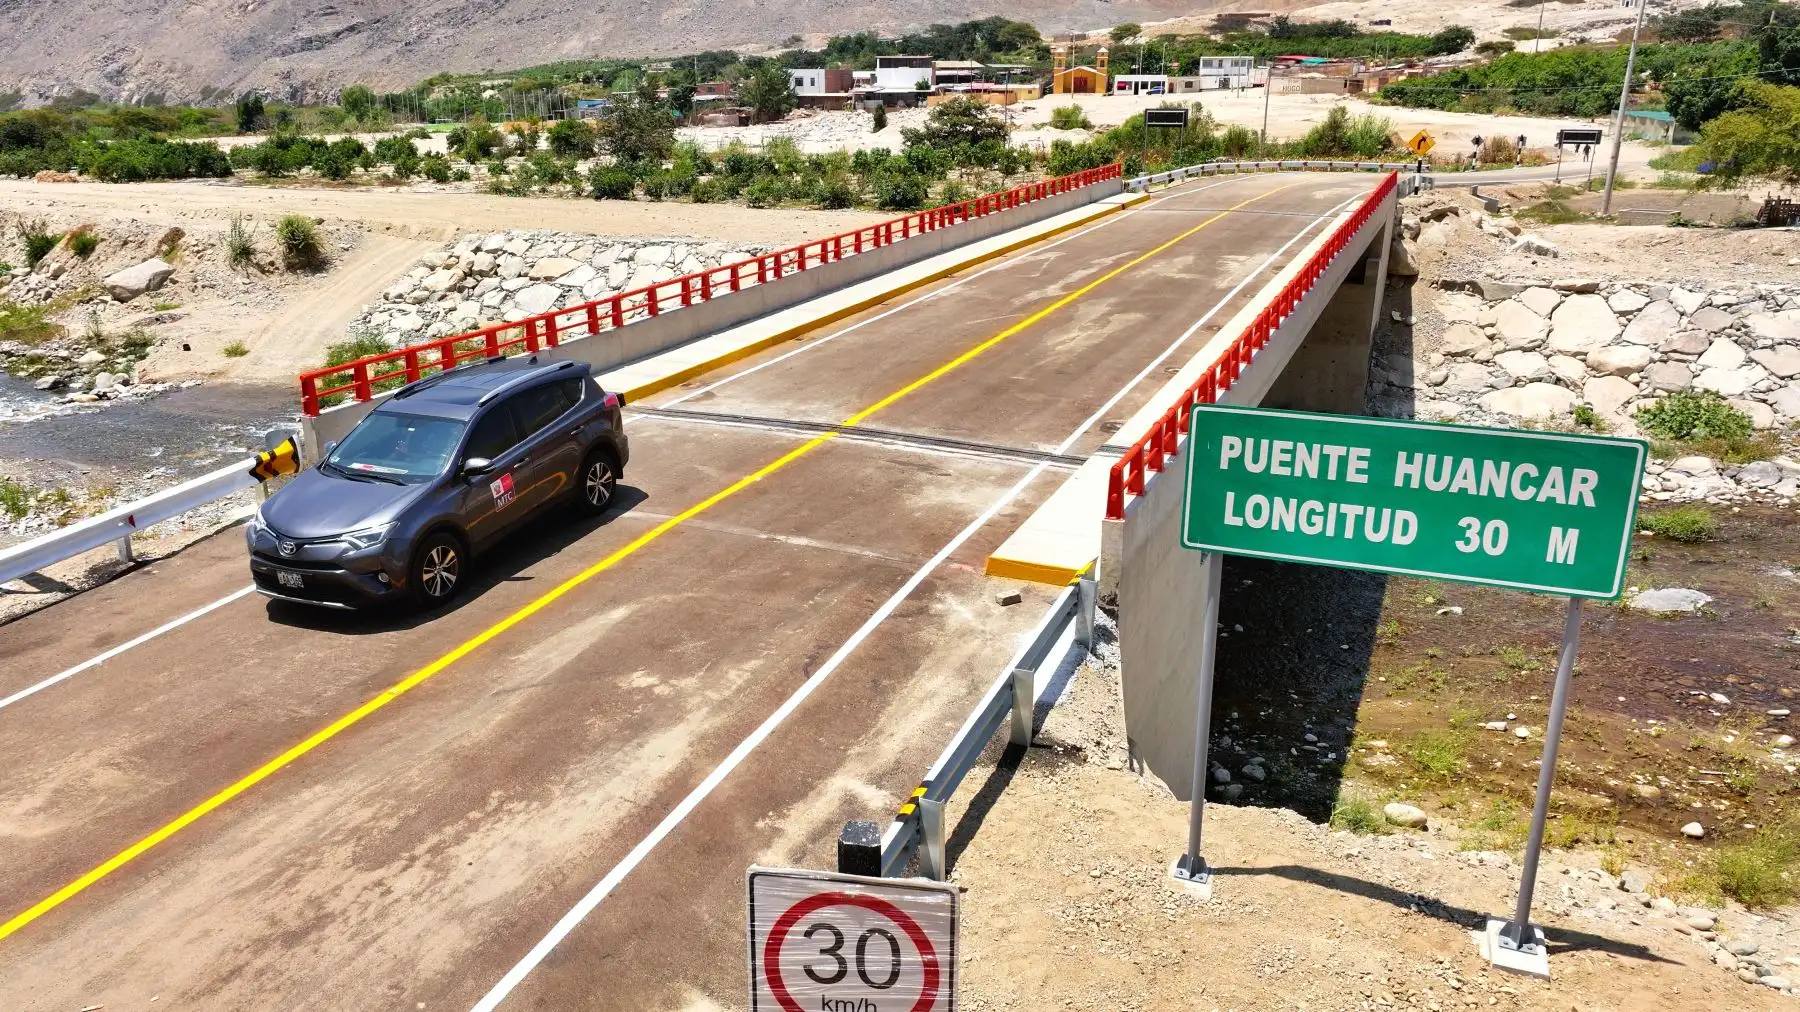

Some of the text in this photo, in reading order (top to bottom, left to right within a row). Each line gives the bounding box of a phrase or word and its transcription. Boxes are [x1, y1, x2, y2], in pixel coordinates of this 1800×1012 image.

[497, 491, 513, 508] MTC
[1219, 435, 1599, 508] PUENTE HUANCAR
[1224, 491, 1580, 565] LONGITUD 30 M
[803, 922, 901, 990] 30
[821, 994, 877, 1012] km/h
